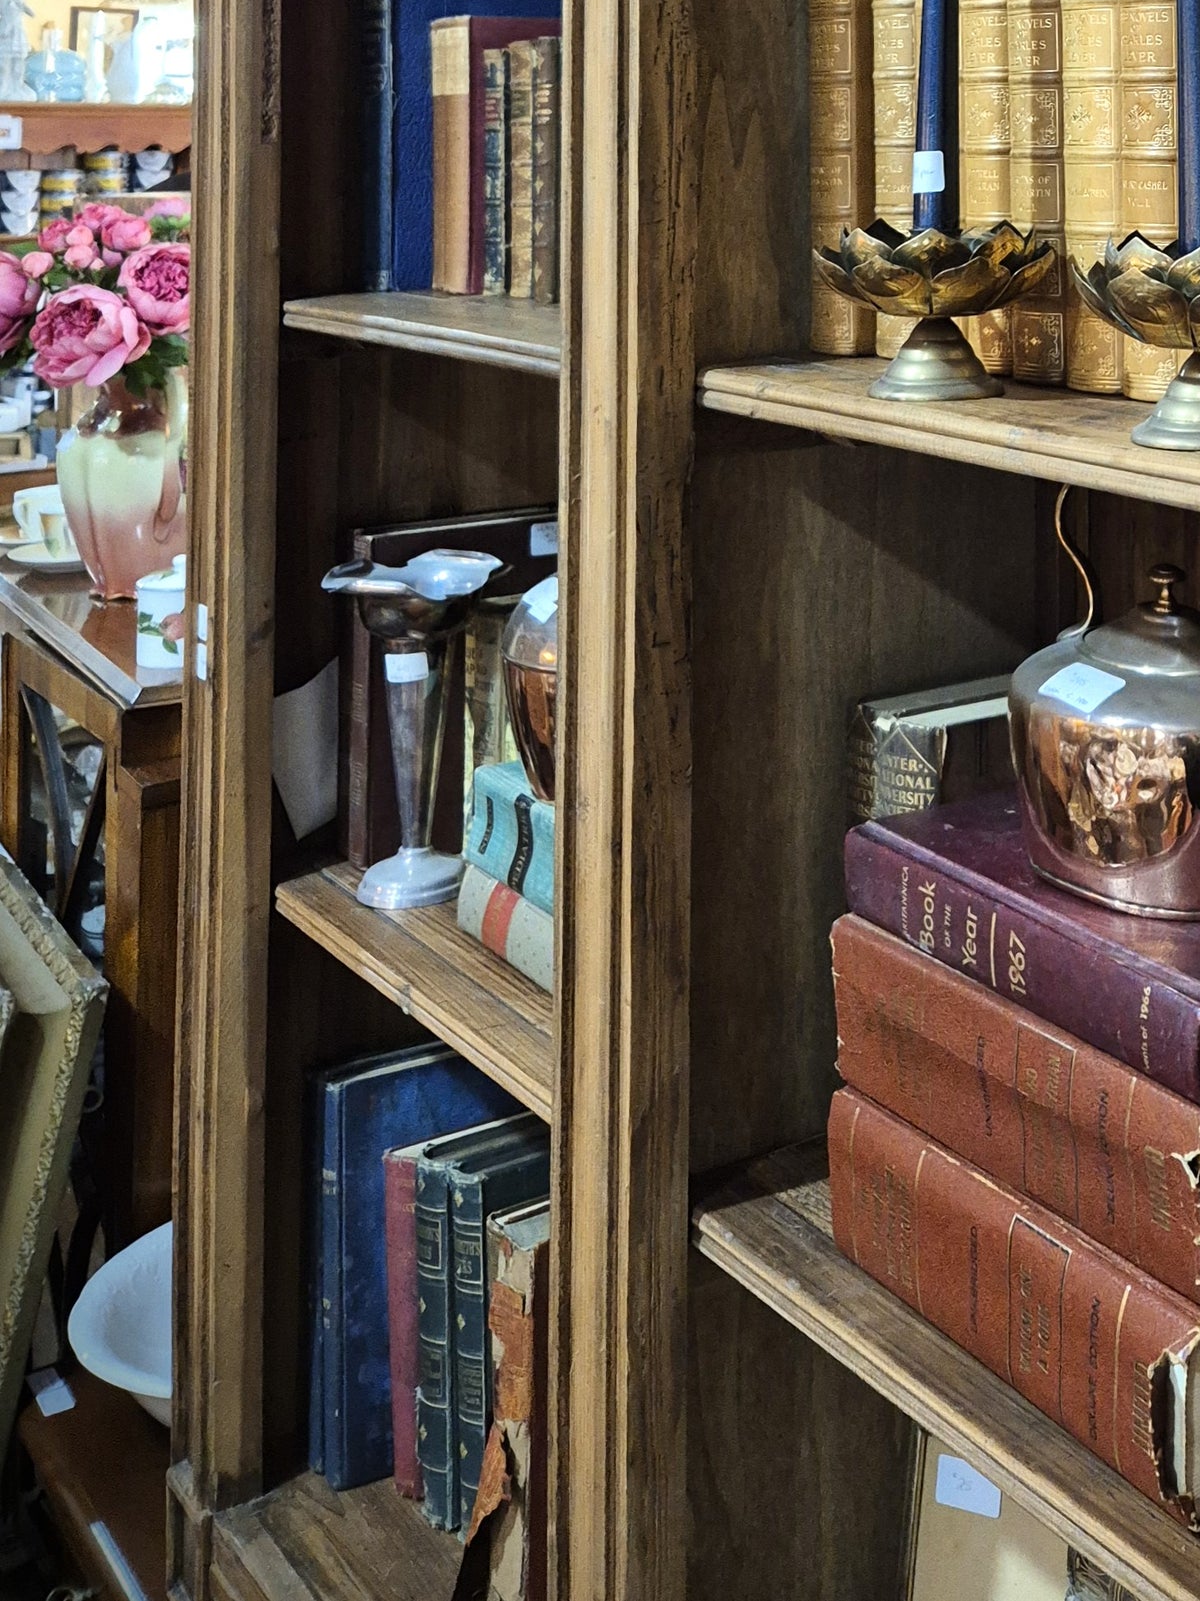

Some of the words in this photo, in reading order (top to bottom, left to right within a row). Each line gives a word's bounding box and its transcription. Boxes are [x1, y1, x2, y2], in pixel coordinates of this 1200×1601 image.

[918, 880, 937, 950] Book
[944, 903, 952, 927] THE
[944, 927, 951, 948] OF
[961, 905, 978, 966] Year
[1007, 929, 1027, 995] 1967
[1139, 985, 1151, 1020] 1966
[1139, 1024, 1148, 1040] of
[1088, 1296, 1100, 1370] EDITION
